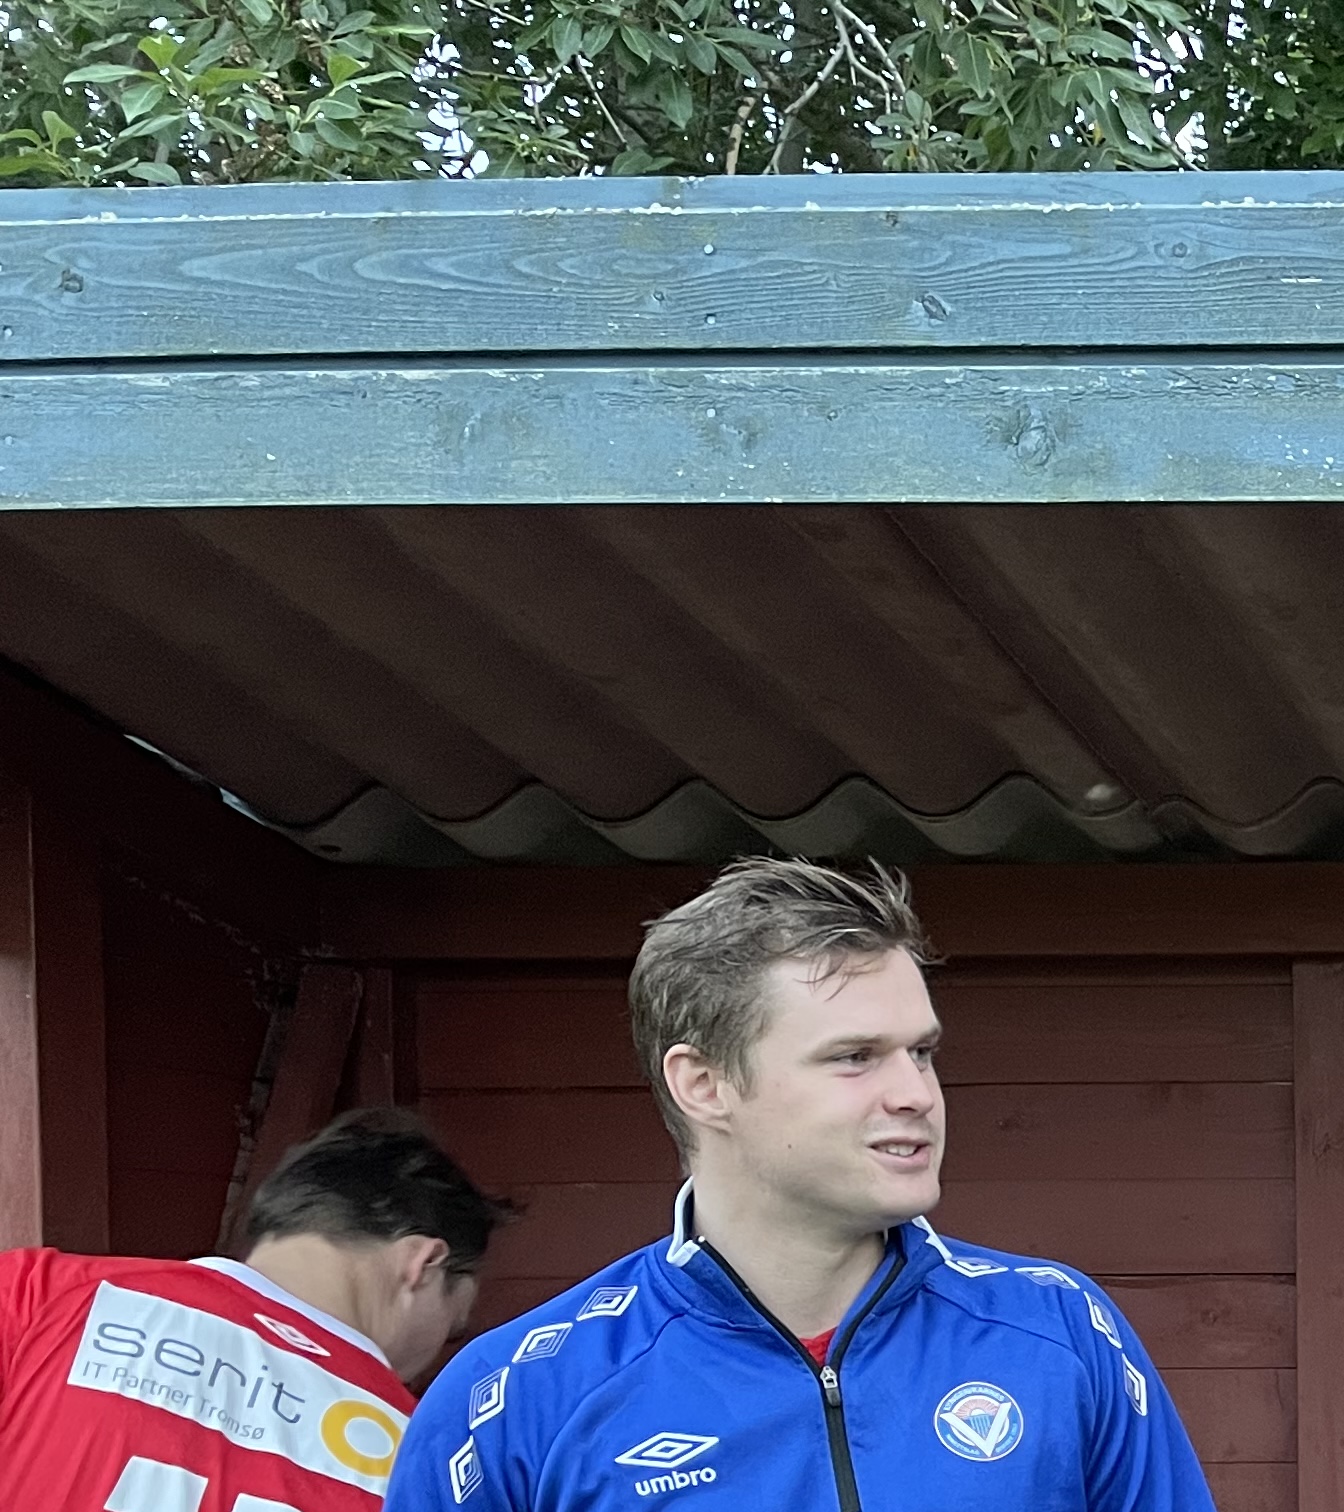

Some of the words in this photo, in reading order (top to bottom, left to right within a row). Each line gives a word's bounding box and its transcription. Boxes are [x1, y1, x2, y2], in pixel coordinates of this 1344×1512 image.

[82, 1360, 108, 1379] IT
[112, 1366, 195, 1407] Partner
[200, 1397, 266, 1440] Tromsø
[93, 1322, 306, 1424] serit
[634, 1466, 717, 1497] umbro
